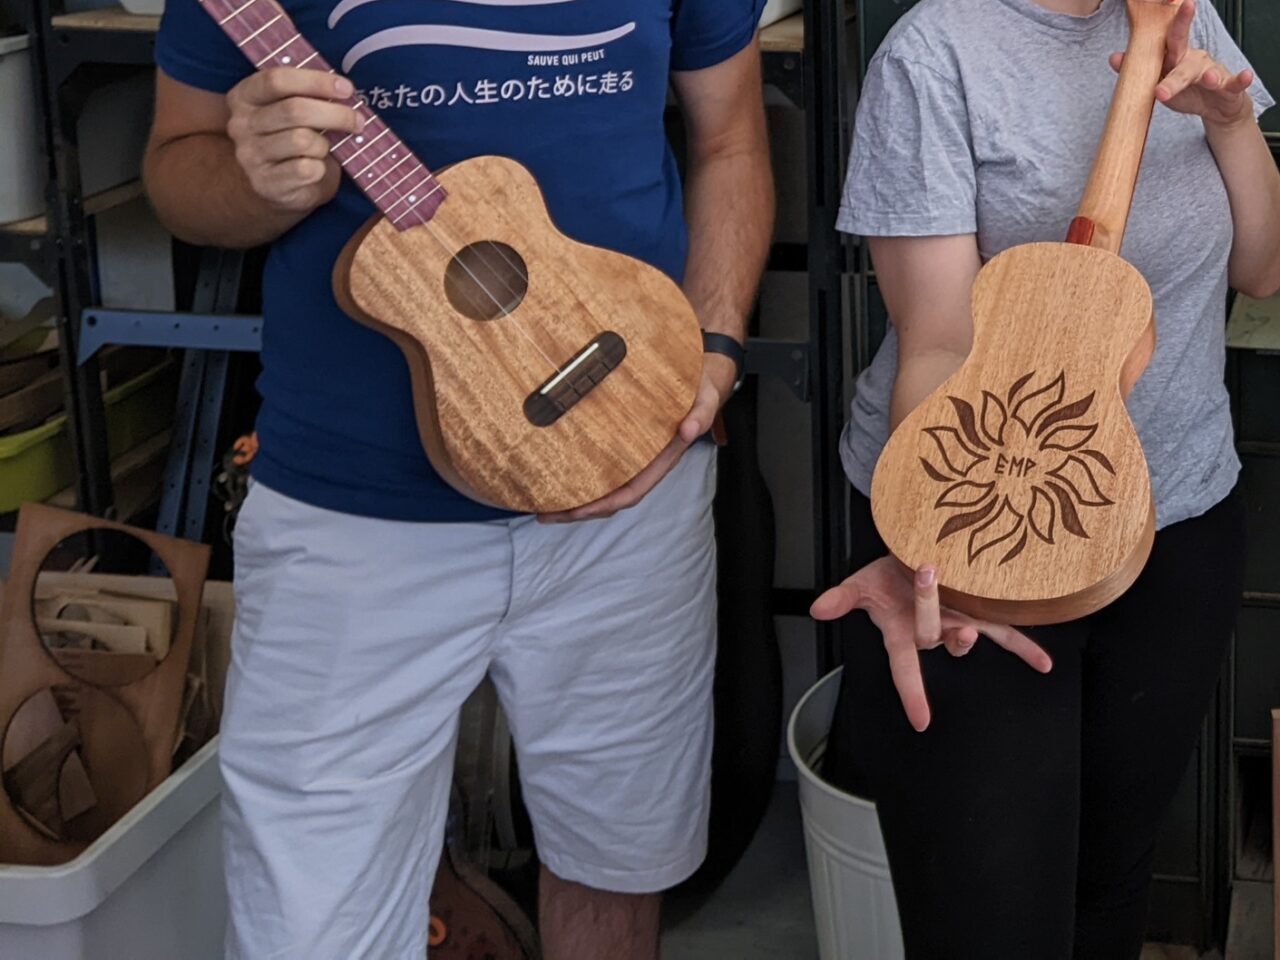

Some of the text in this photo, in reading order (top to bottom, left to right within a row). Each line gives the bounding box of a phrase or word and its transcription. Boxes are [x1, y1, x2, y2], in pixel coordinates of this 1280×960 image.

[527, 48, 605, 66] SAUVE QUI PEUT
[994, 452, 1037, 477] EMP
